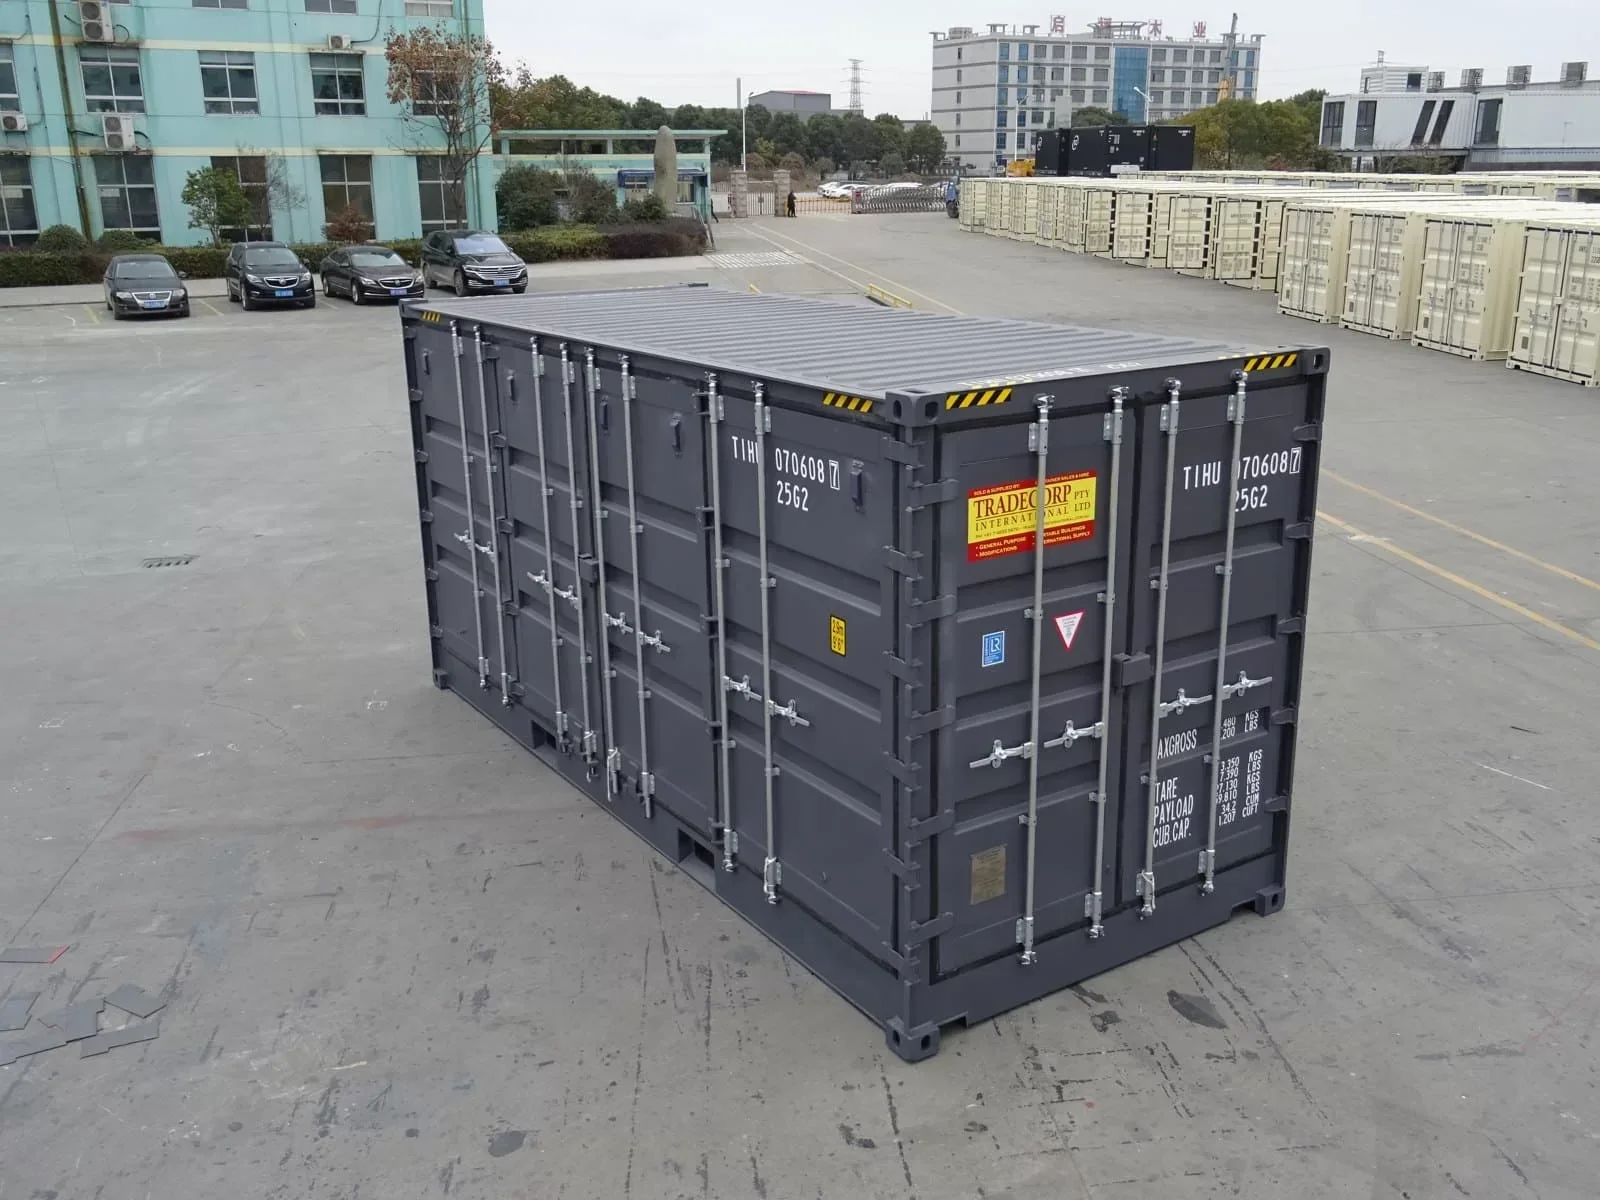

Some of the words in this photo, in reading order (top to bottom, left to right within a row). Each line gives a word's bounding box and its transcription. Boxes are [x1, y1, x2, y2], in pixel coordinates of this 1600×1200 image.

[1183, 461, 1221, 490] TIHU
[776, 480, 809, 512] 25G2
[1074, 489, 1090, 500] PTY
[1074, 501, 1091, 512] LTD
[975, 506, 1069, 532] INTERNATINAL
[1157, 729, 1197, 760] AXGROSS
[1248, 749, 1263, 762] KGS
[1247, 760, 1261, 774] LBS
[1246, 771, 1261, 785] KGS
[1155, 777, 1178, 803] TARE
[1246, 781, 1260, 795] LBS
[1245, 792, 1259, 806] CUM
[1153, 794, 1193, 826] PAYLOAD
